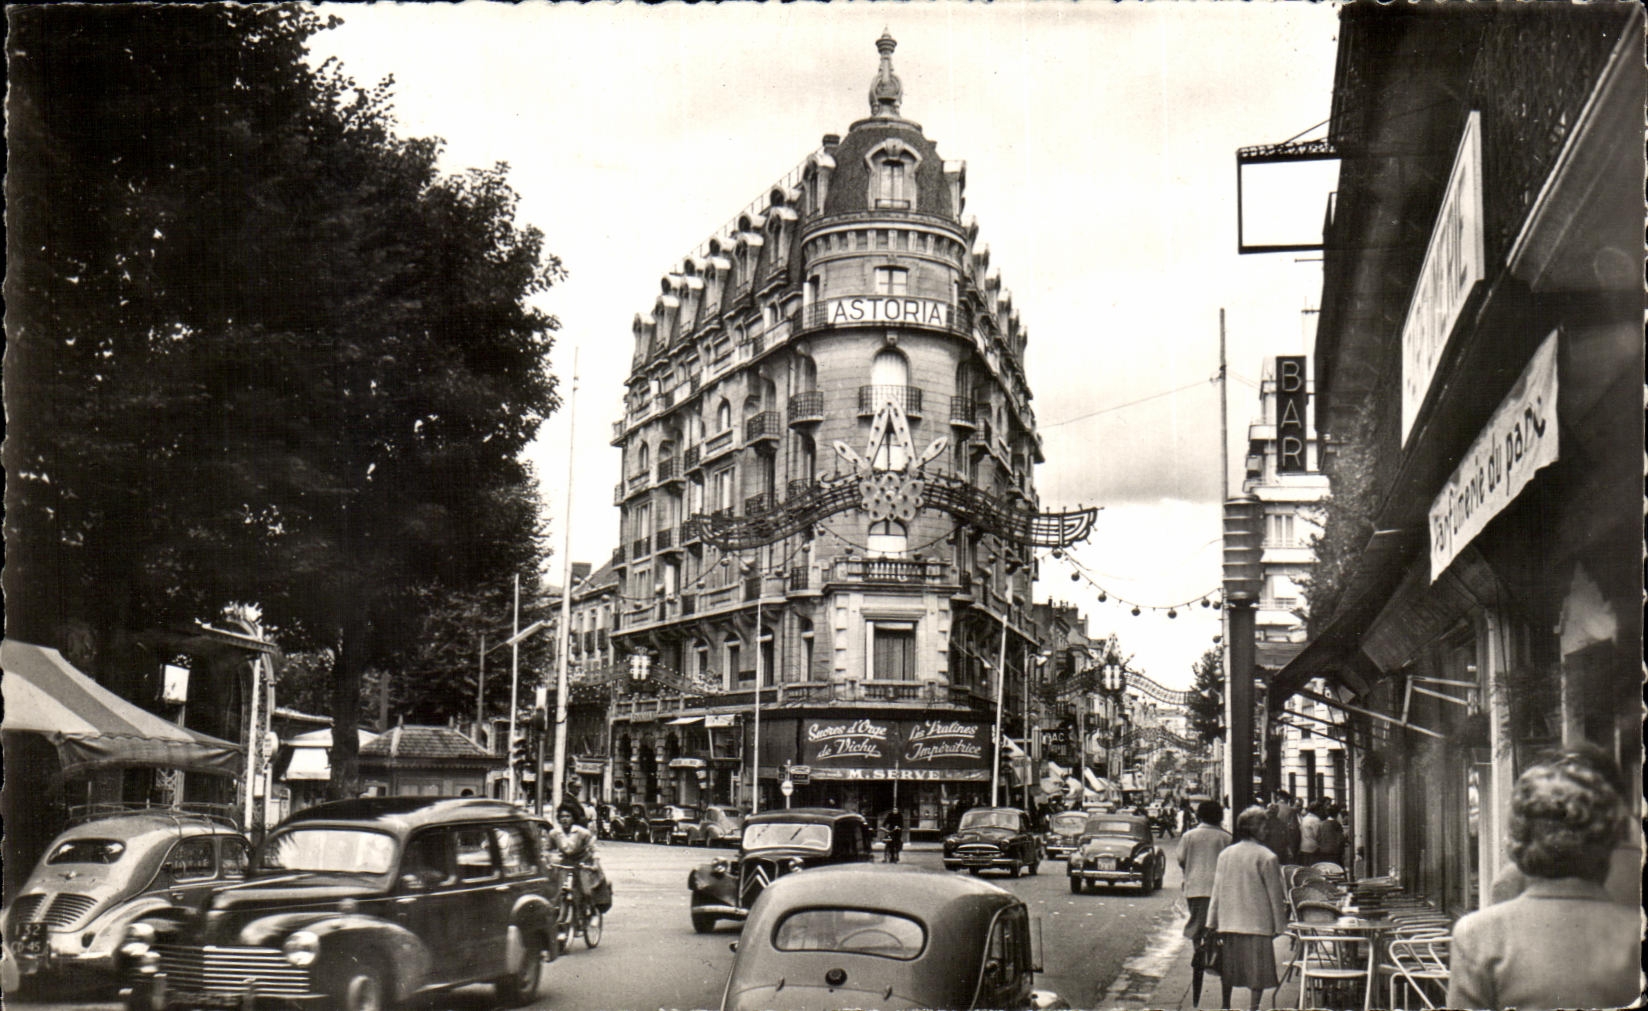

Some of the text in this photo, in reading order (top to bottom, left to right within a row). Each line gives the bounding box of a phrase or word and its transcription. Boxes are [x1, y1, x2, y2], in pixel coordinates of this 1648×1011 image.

[833, 299, 943, 325] ASTORIA
[1281, 361, 1302, 467] BAR
[1487, 432, 1502, 493] du
[808, 719, 888, 742] Sucres d'Orge
[909, 719, 979, 741] Les Pralines
[817, 738, 877, 760] de Vichy
[905, 739, 982, 762] Impératrice
[848, 769, 870, 780] M.
[877, 769, 940, 780] SERVE
